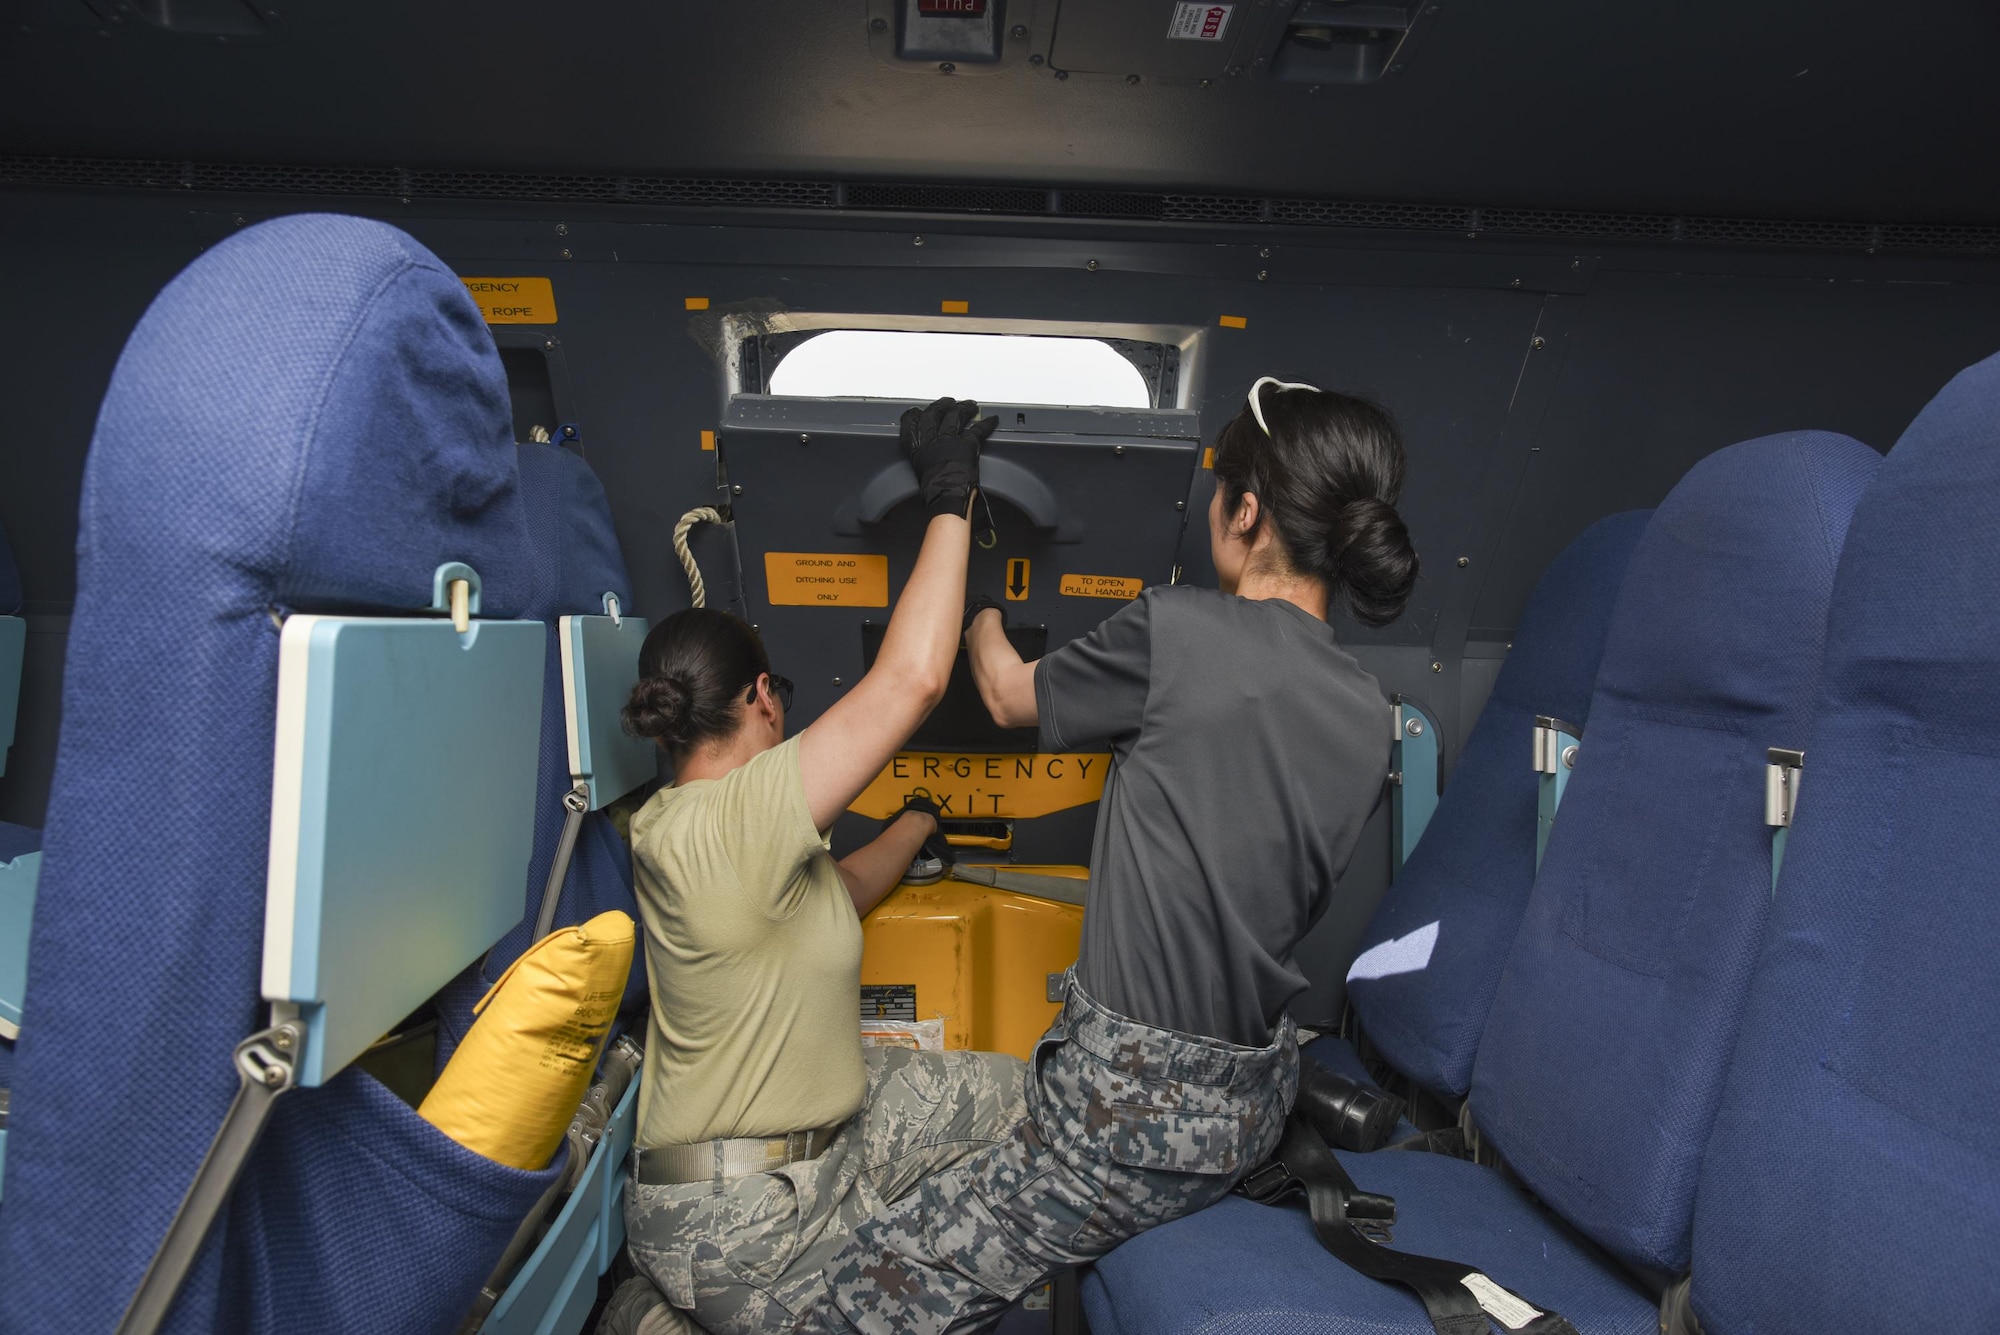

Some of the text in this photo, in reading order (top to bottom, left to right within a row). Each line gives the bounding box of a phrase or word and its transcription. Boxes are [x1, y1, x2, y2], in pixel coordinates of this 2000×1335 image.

[1193, 7, 1203, 23] OXYGEN
[1183, 9, 1195, 33] EMERGENCY
[1202, 10, 1223, 38] PUSH
[1173, 20, 1185, 37] RELEASE
[464, 283, 520, 292] GENCY
[493, 307, 533, 316] ROPE
[795, 559, 856, 568] GROUND AND
[795, 576, 858, 585] DITCHING USE
[1081, 577, 1125, 587] TO OPEN
[1064, 586, 1136, 597] PULL HANDLE
[816, 593, 839, 601] ONLY
[893, 757, 1093, 779] ERGENCY
